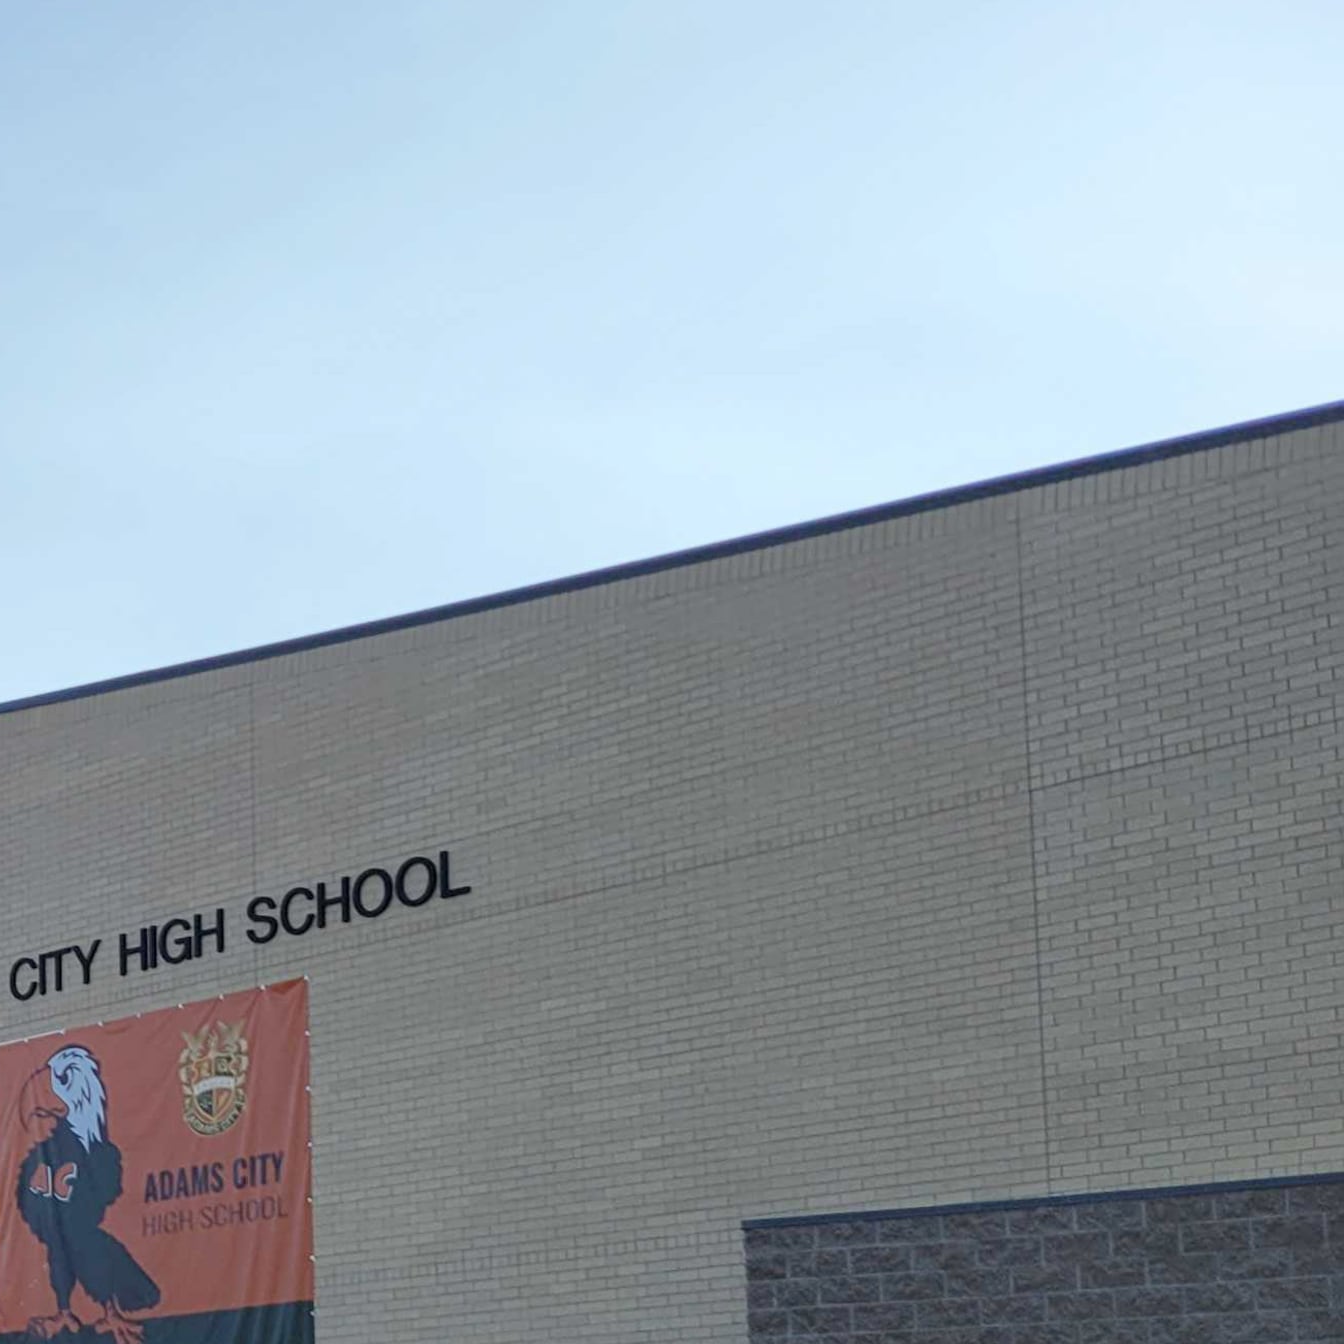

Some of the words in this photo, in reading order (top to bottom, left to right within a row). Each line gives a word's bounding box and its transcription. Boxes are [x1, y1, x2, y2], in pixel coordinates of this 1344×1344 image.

[10, 939, 101, 1001] CITY
[118, 908, 226, 976] HIGH
[246, 850, 472, 944] SCHOOL
[144, 1161, 224, 1204] ADAMS
[233, 1152, 284, 1189] CITY
[141, 1212, 195, 1238] HIGH
[199, 1196, 290, 1230] SCHOOL
